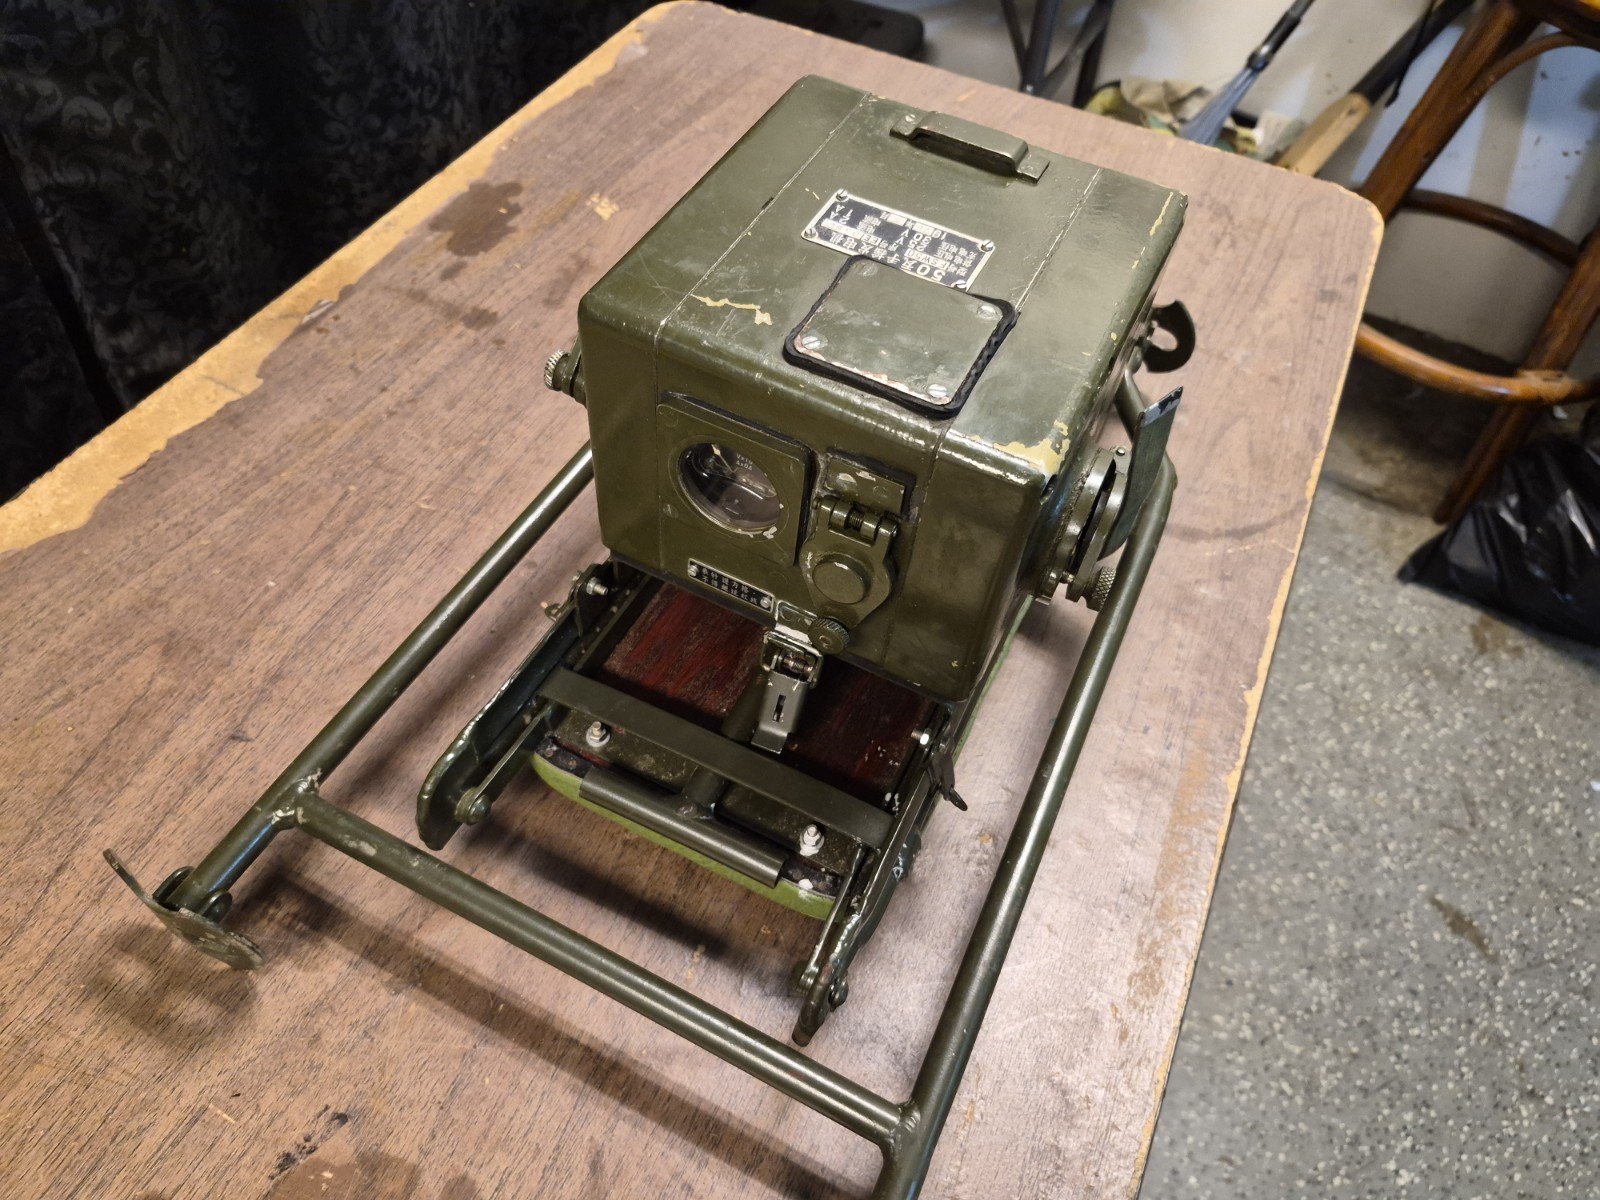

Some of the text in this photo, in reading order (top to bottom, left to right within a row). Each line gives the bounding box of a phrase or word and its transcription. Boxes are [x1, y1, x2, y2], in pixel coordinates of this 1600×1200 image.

[833, 203, 845, 213] A
[827, 211, 839, 220] A
[900, 227, 911, 236] V
[894, 235, 906, 244] V
[912, 231, 932, 243] 30
[907, 239, 927, 251] 25
